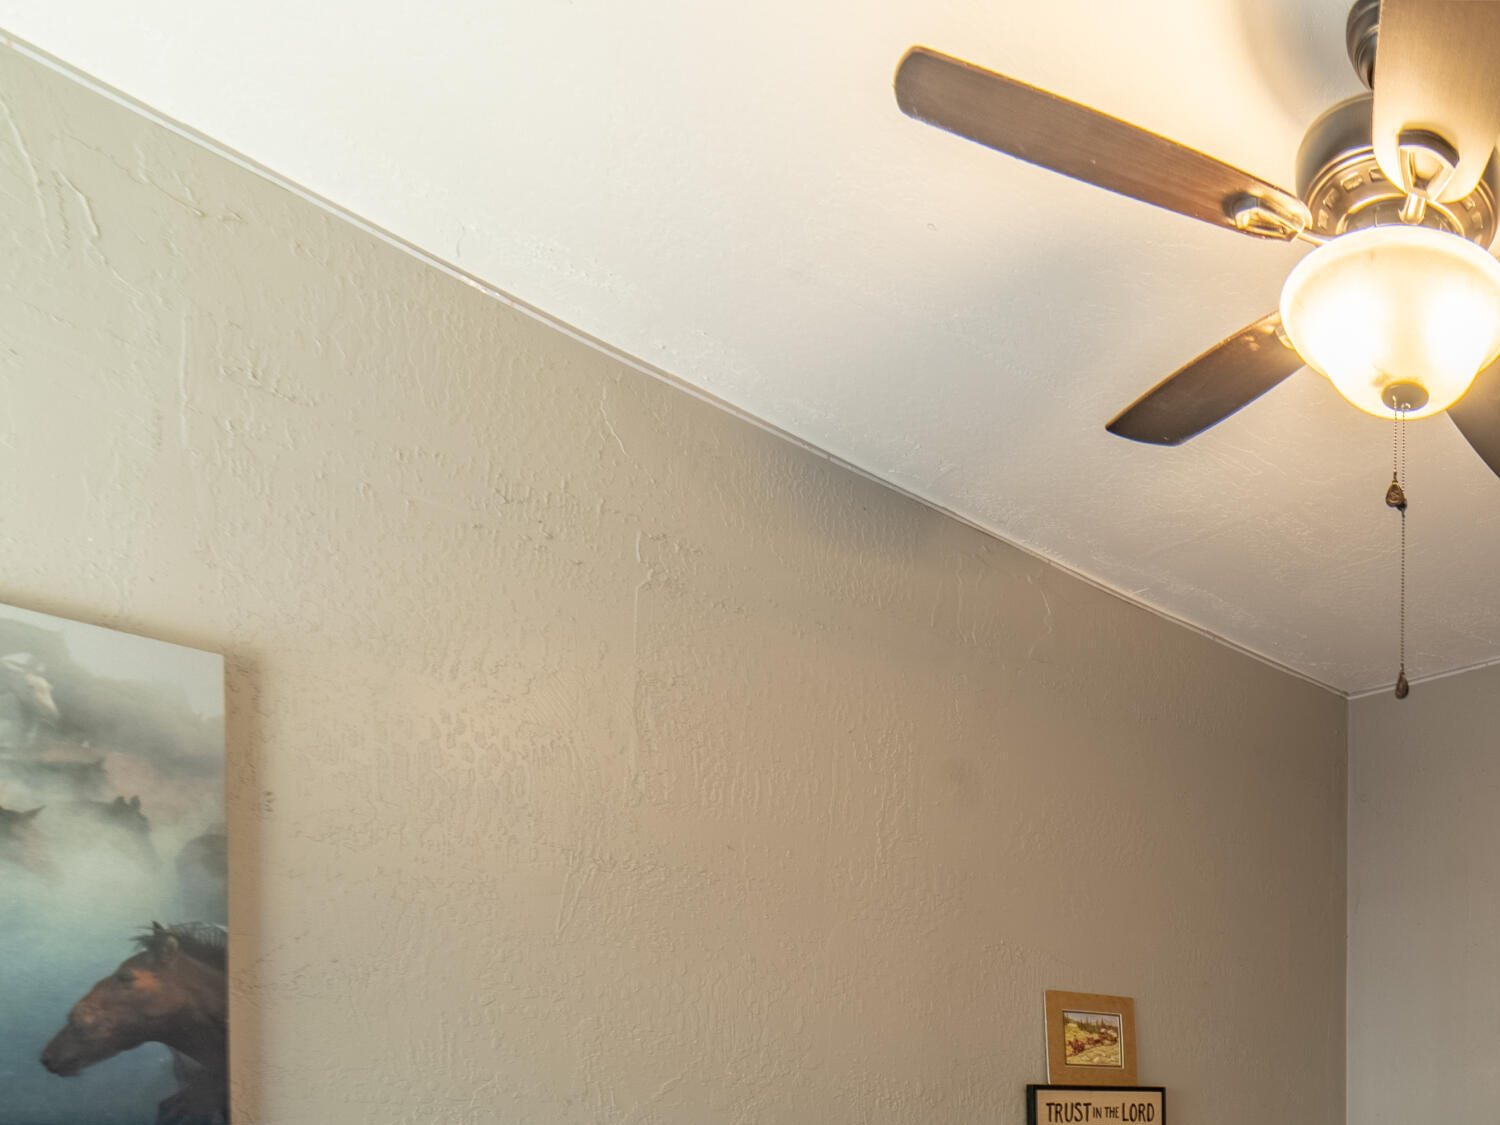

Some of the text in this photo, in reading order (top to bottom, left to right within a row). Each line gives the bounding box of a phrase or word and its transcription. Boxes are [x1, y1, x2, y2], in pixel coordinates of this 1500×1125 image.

[1045, 1102, 1155, 1123] TRUST IN THE LORD
